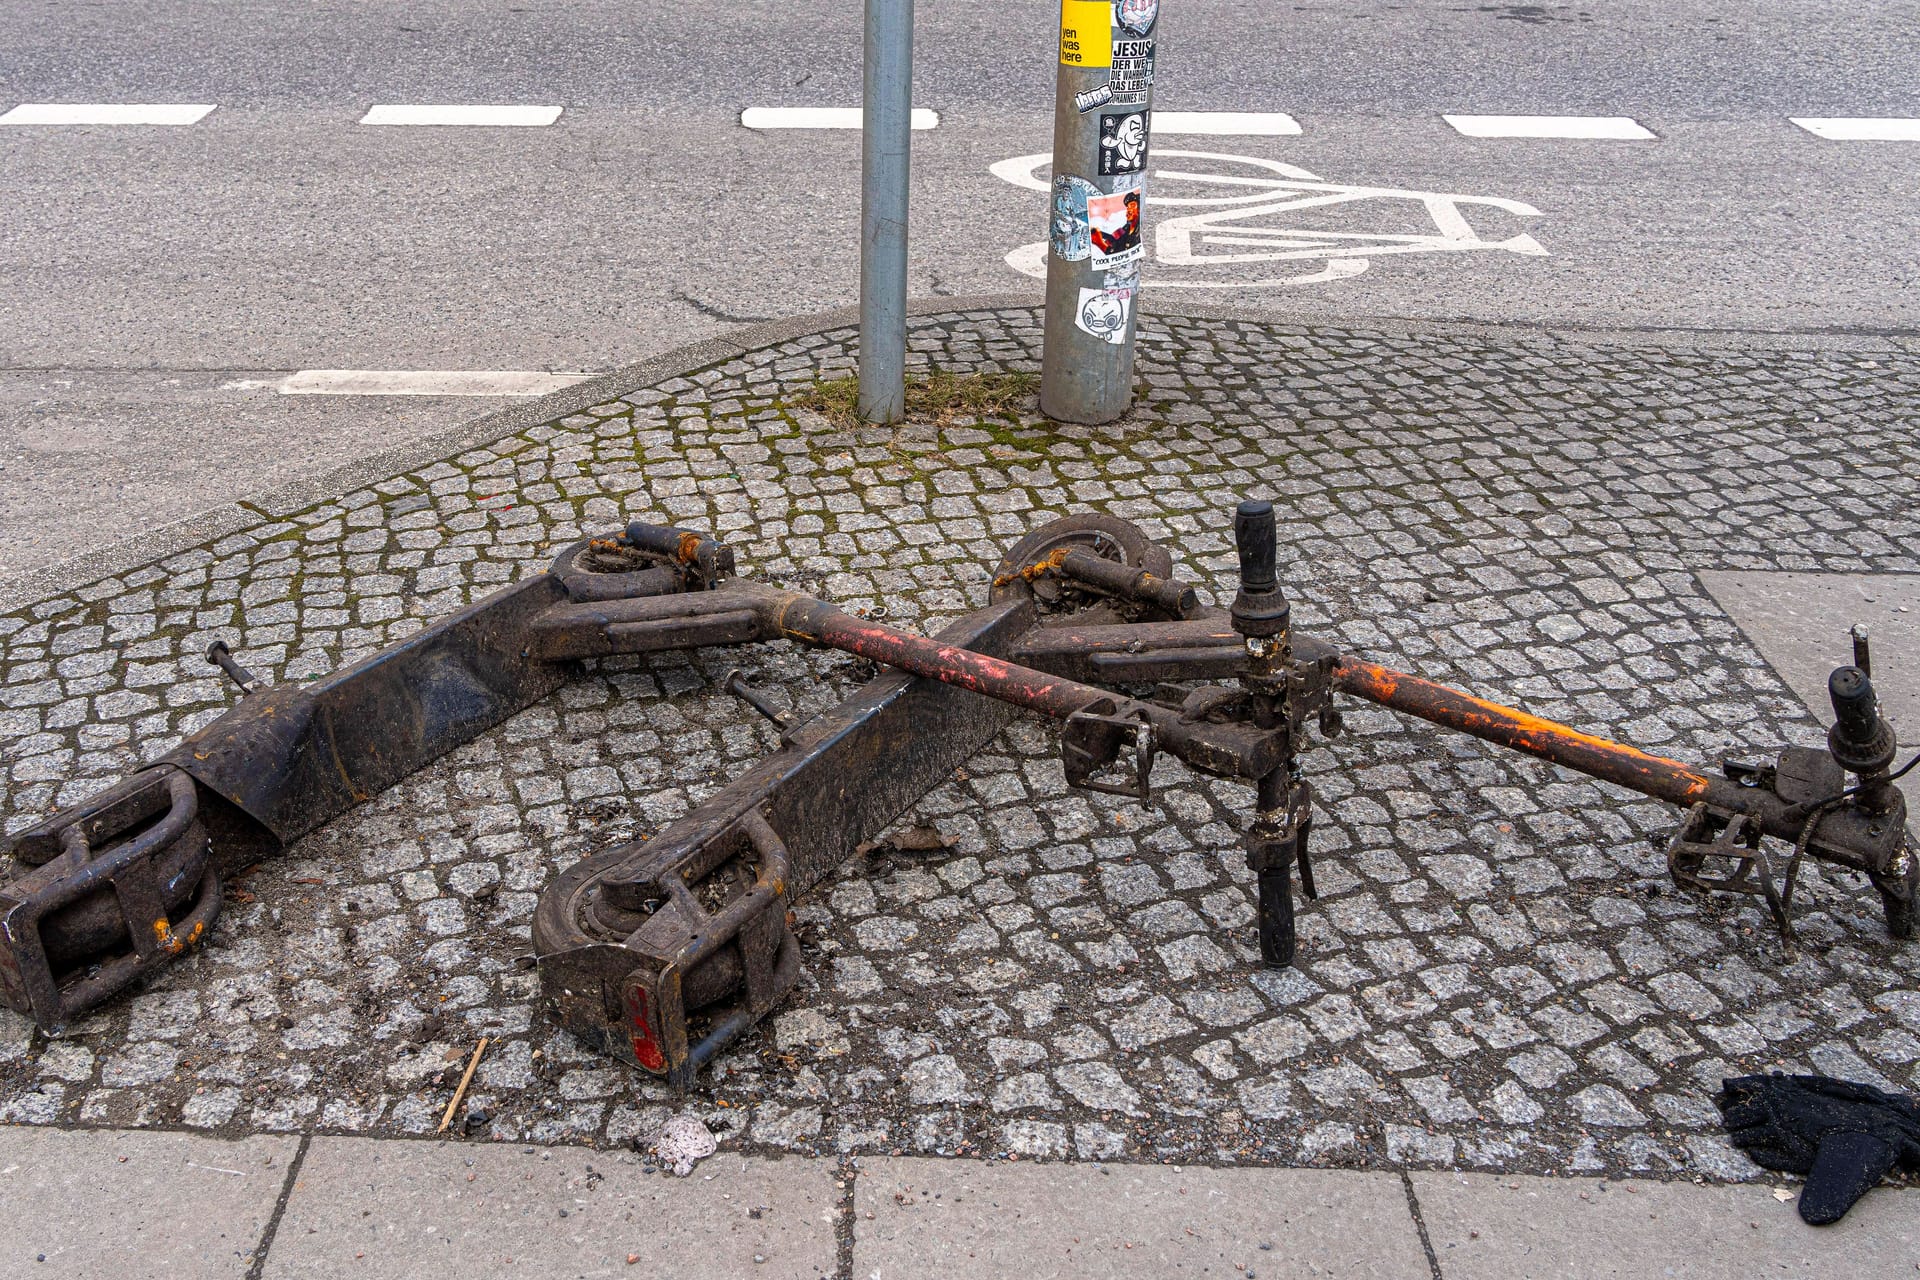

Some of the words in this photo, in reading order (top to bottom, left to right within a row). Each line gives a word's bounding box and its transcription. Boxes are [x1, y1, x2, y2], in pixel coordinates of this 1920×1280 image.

[1062, 41, 1080, 51] was
[1113, 41, 1151, 57] JESUS
[1061, 49, 1082, 63] here
[1112, 60, 1131, 70] DER
[1133, 59, 1147, 69] WE
[1111, 70, 1121, 81] DIE
[1110, 81, 1126, 91] DAS
